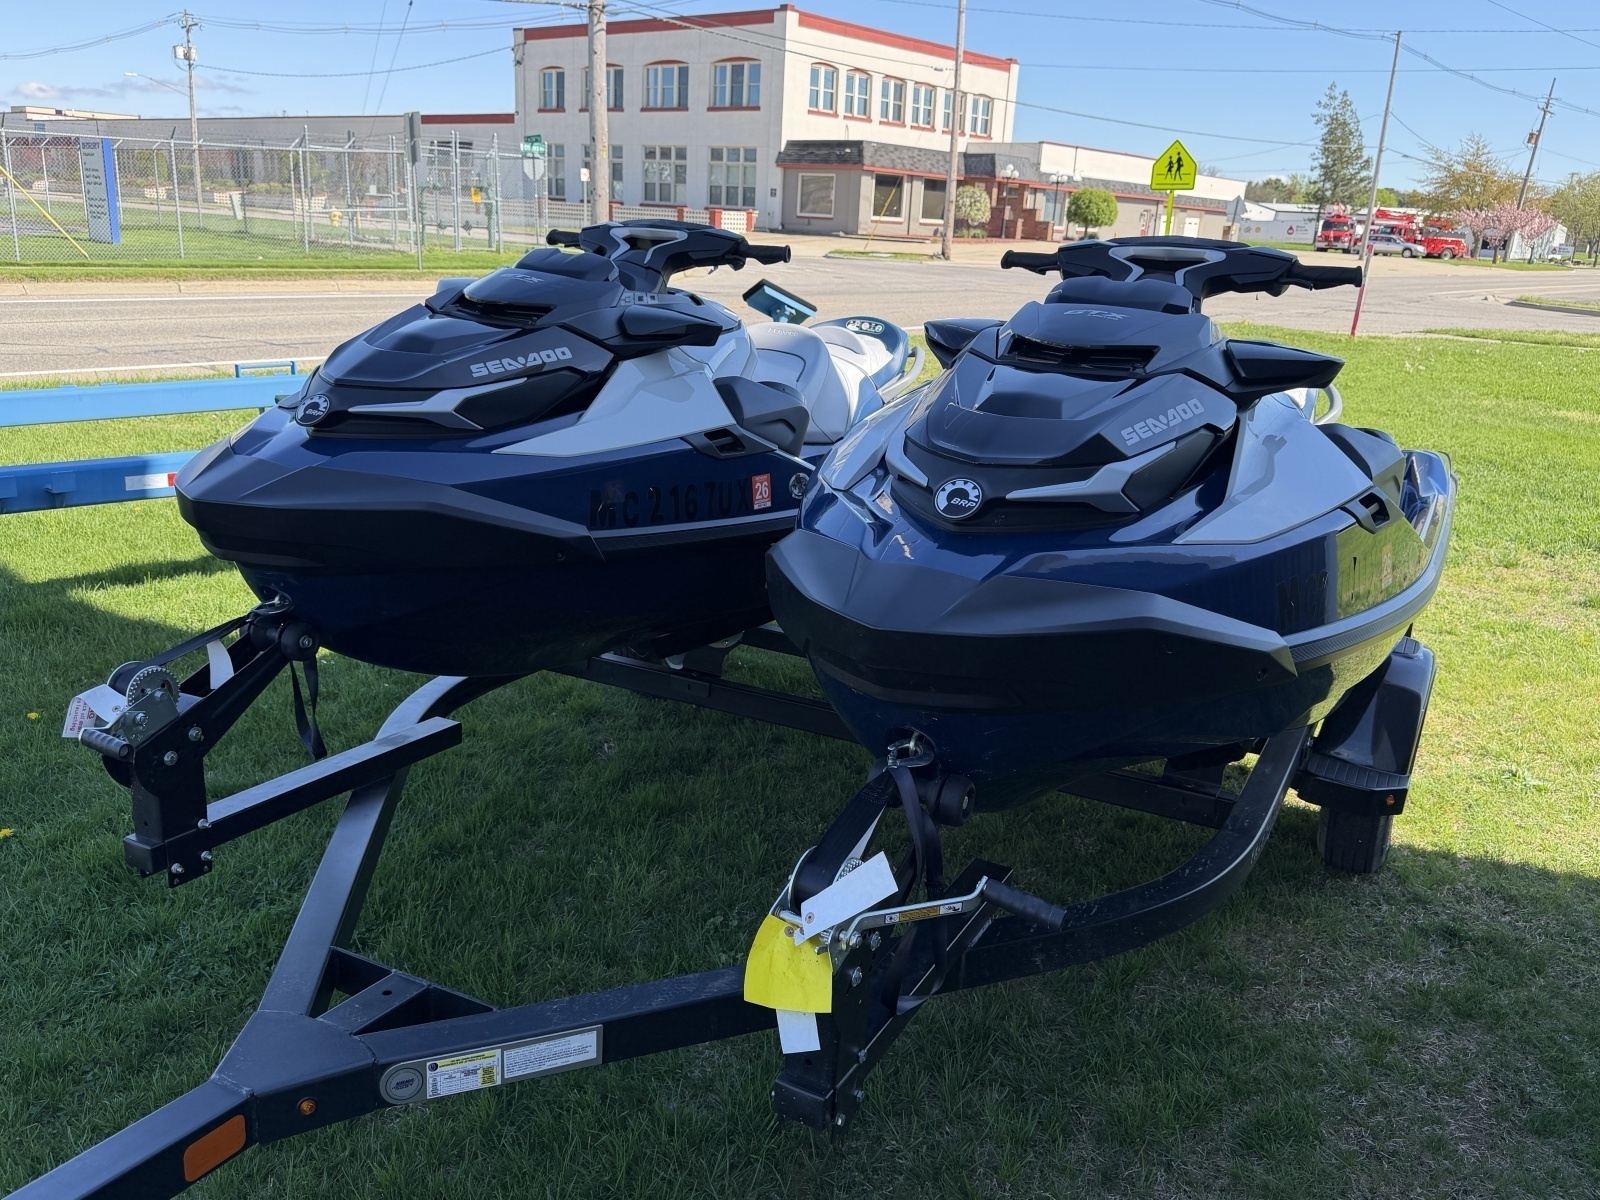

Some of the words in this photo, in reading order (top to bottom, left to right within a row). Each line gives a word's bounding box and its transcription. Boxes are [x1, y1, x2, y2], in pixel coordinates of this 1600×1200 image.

[620, 292, 659, 306] 300
[754, 481, 769, 500] 26
[950, 497, 976, 508] BRP
